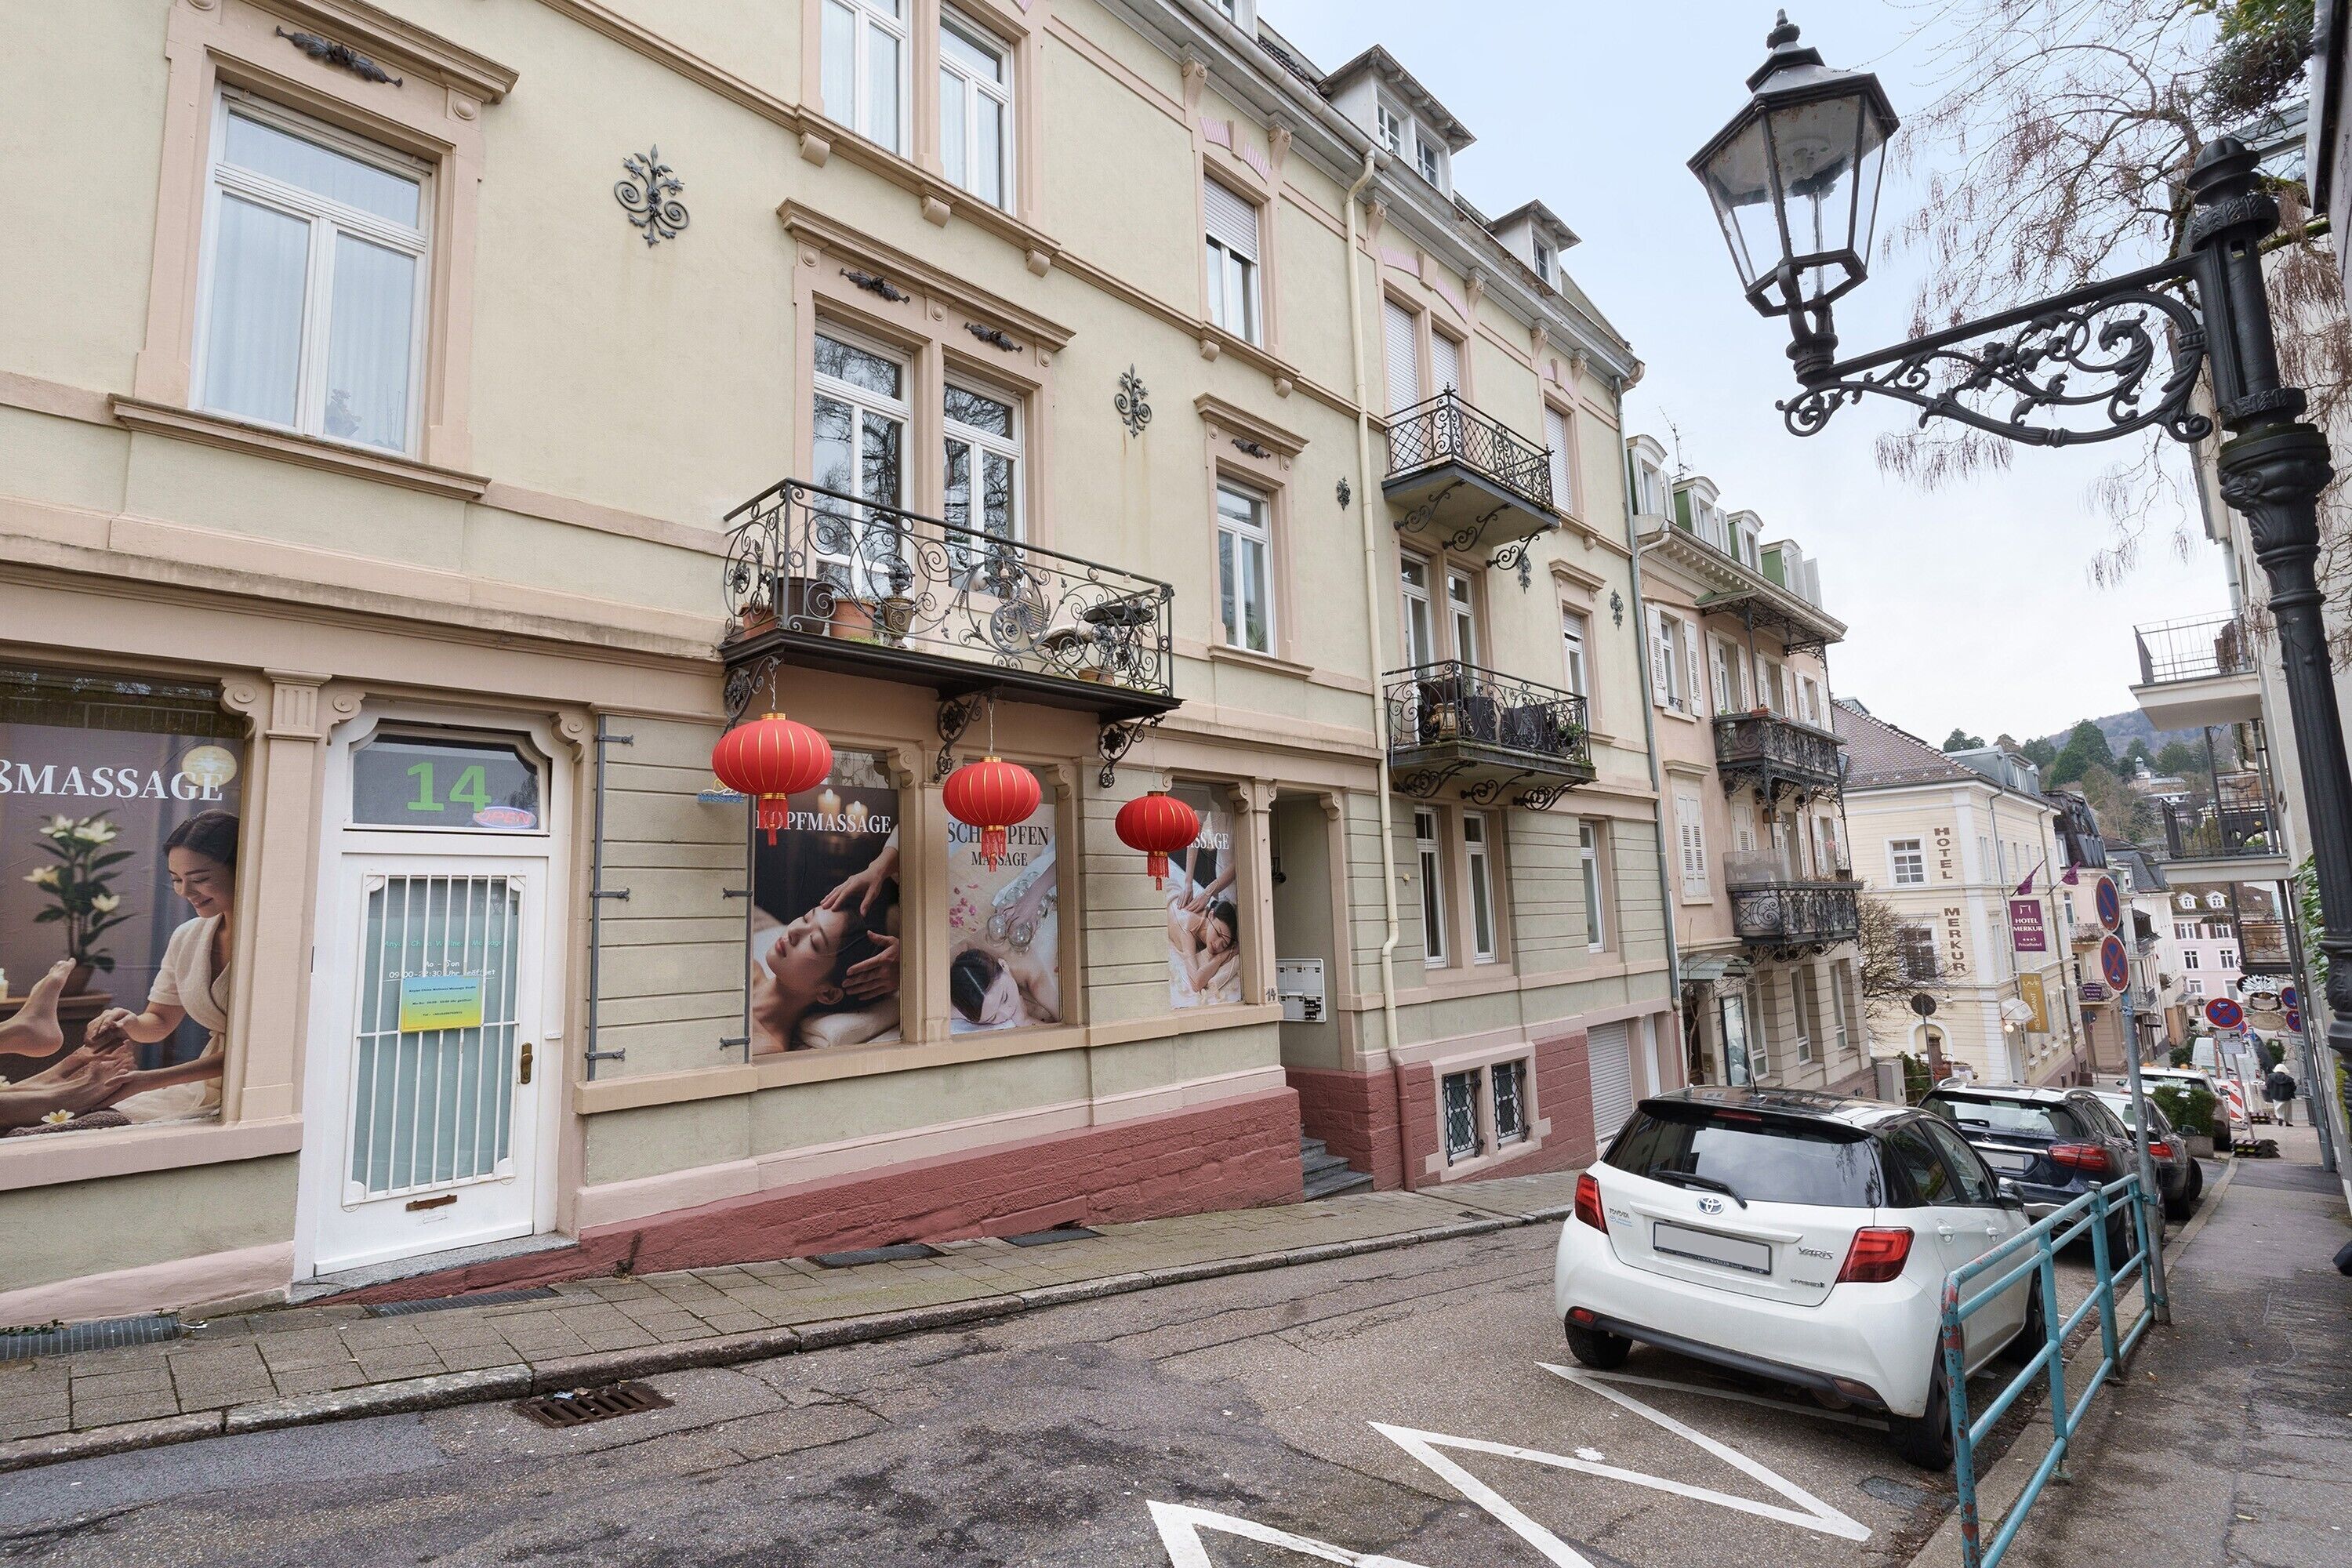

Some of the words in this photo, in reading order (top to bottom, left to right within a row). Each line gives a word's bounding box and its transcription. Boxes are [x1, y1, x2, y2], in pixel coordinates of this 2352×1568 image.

[406, 761, 492, 812] 14
[477, 810, 531, 825] OPEN
[947, 822, 1049, 846] SCHPFEN
[1934, 827, 1953, 880] HOTEL
[1944, 907, 1966, 971] MERKUR
[1266, 988, 1276, 1001] 14
[2031, 993, 2041, 1029] RESTAURANT
